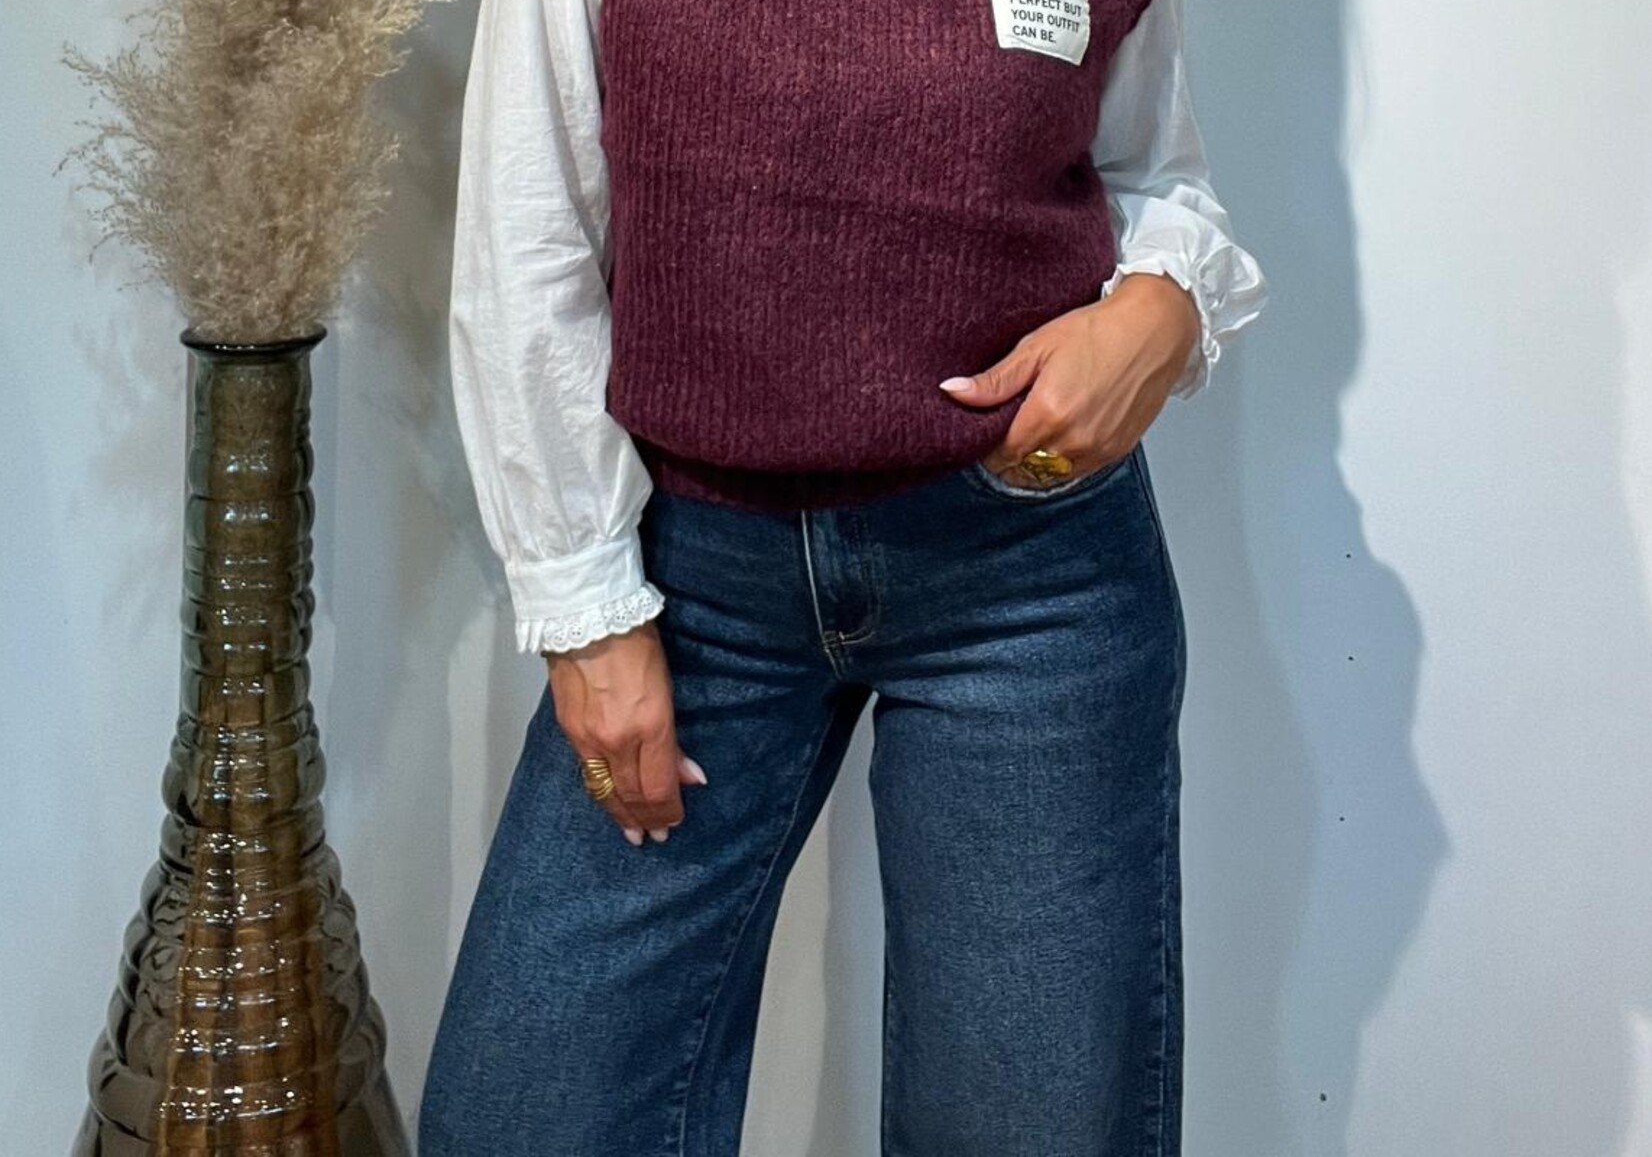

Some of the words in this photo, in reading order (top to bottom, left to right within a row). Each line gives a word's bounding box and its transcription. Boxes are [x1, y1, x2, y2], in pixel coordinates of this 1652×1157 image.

[1064, 2, 1082, 17] BUT
[1011, 9, 1044, 23] YOUR
[1047, 14, 1080, 33] OUTFIT
[1012, 25, 1037, 38] CAN
